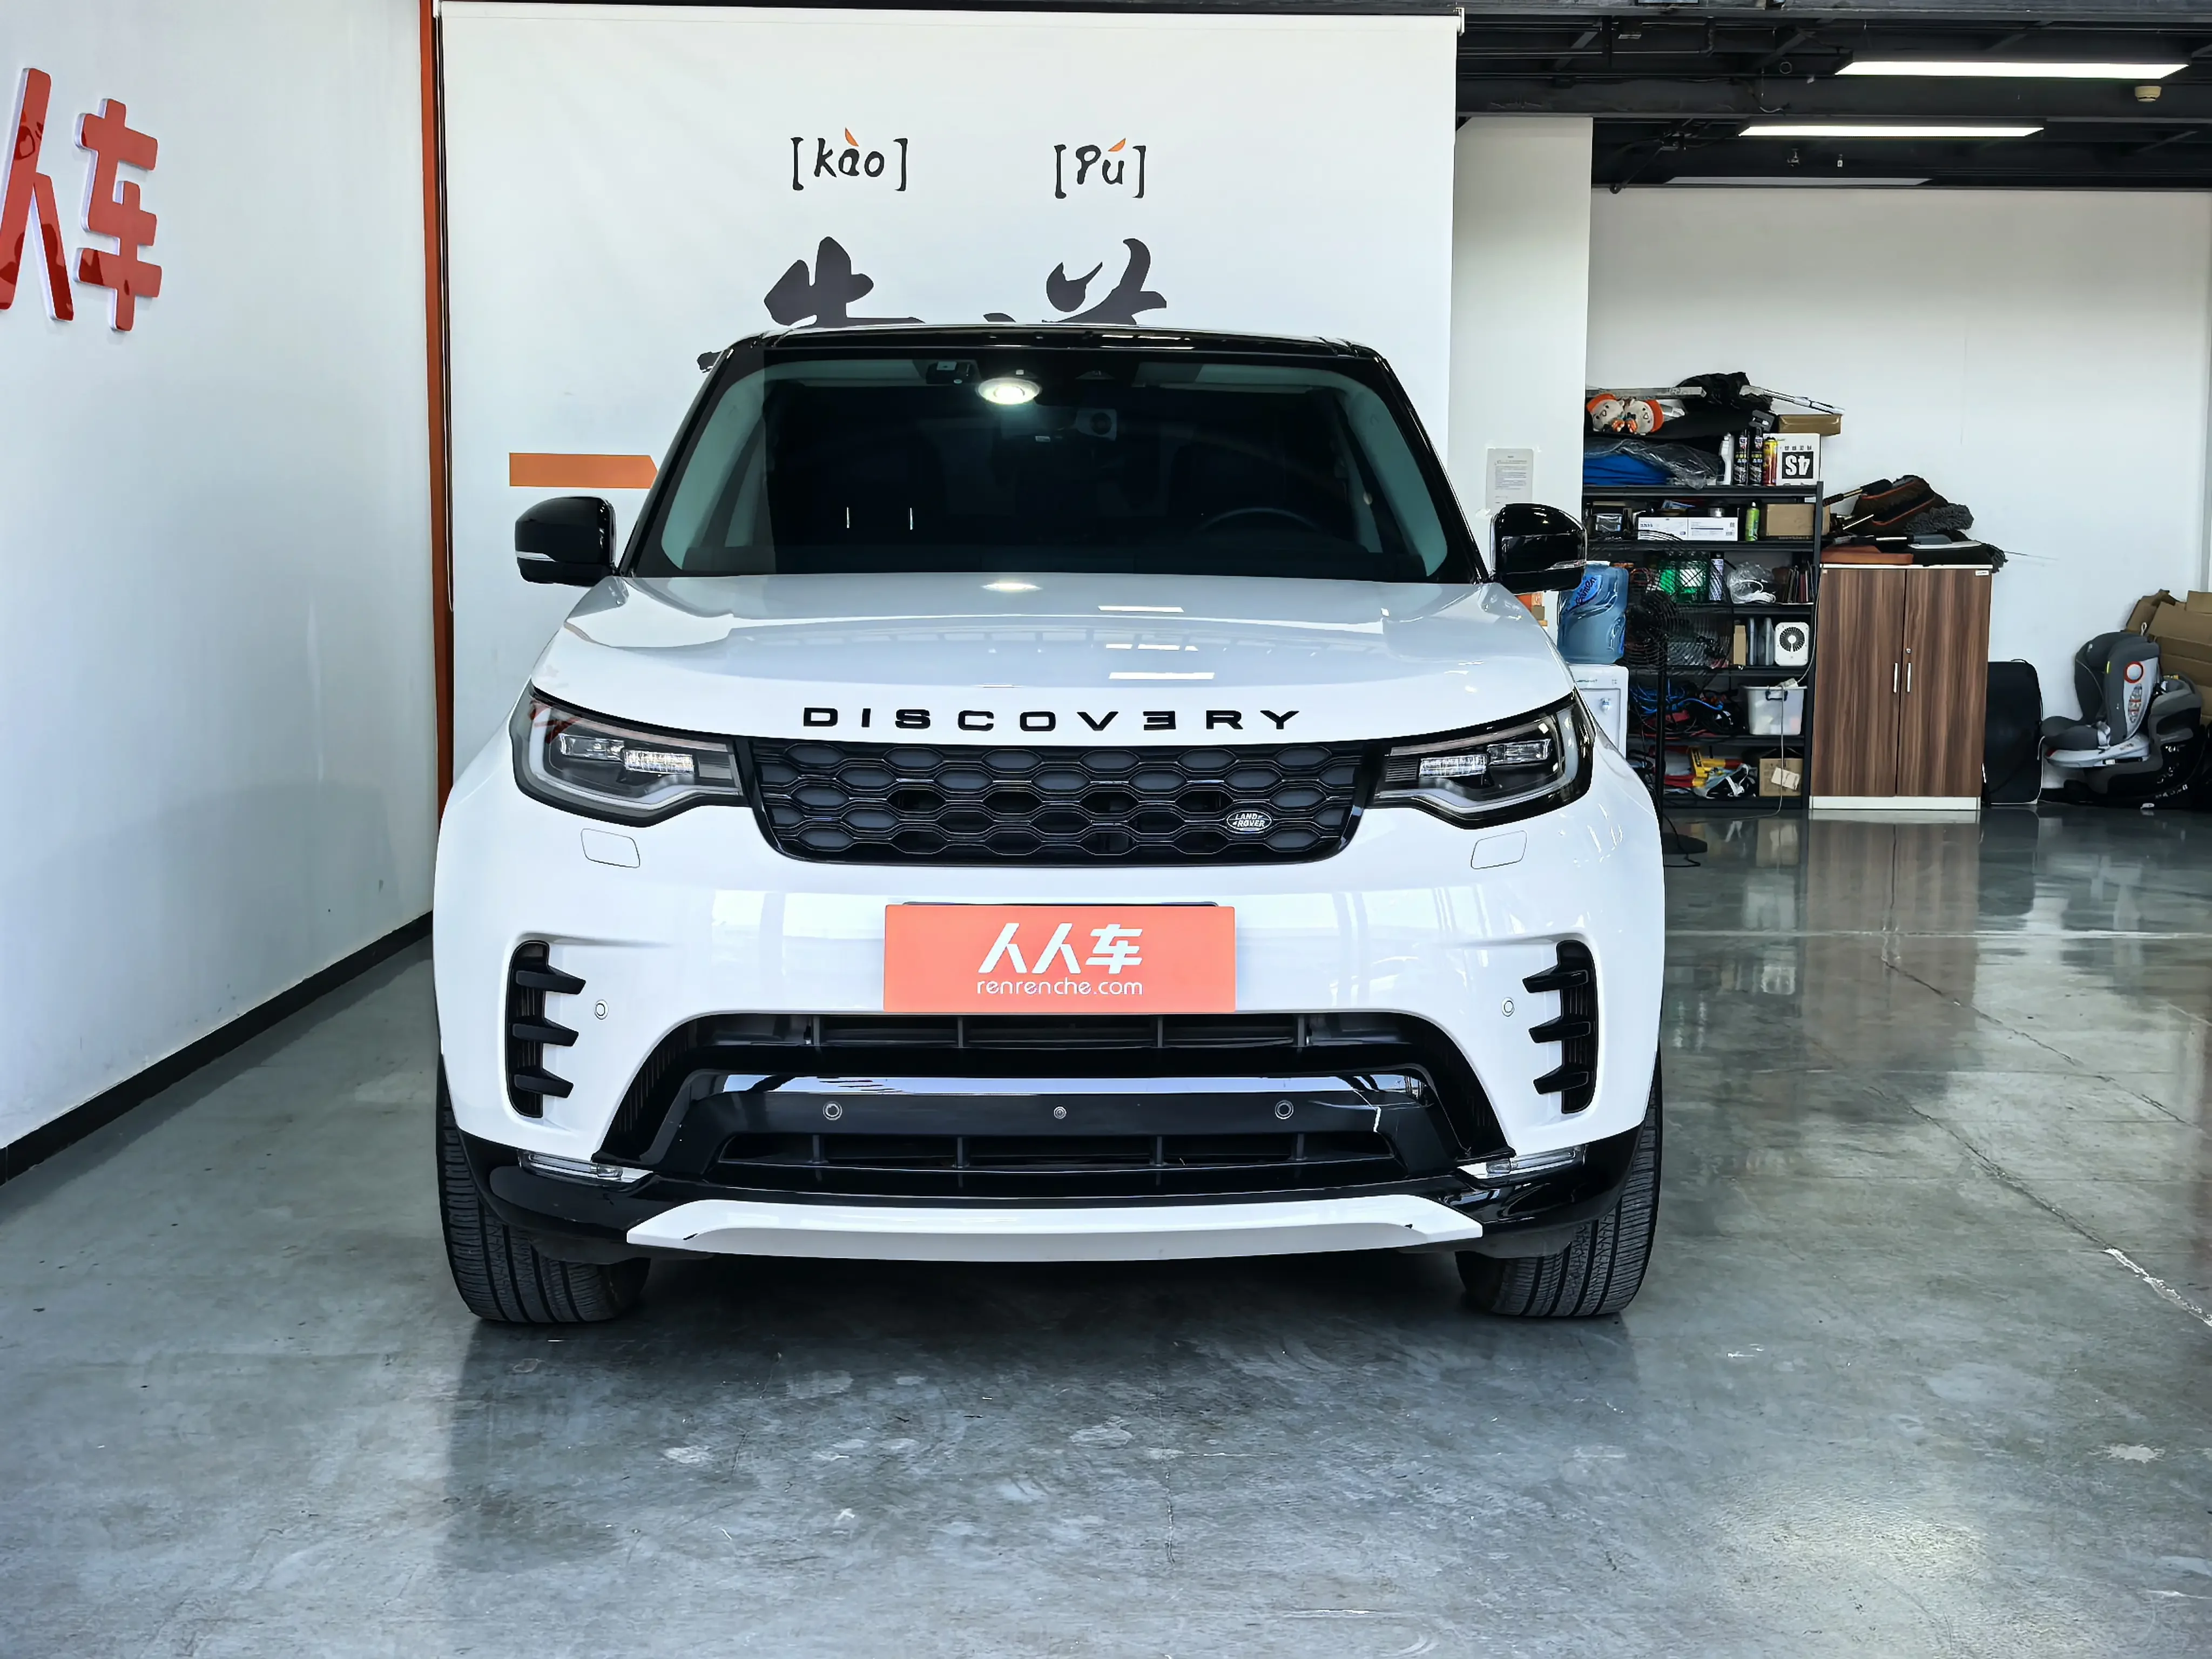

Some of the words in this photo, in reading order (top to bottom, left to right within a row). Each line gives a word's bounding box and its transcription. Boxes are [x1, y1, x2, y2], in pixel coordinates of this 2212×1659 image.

[1785, 455, 1810, 476] 4S
[803, 707, 1299, 731] DISCOVERY
[977, 922, 1143, 974] 人人车
[976, 977, 1143, 995] renrenche.com
